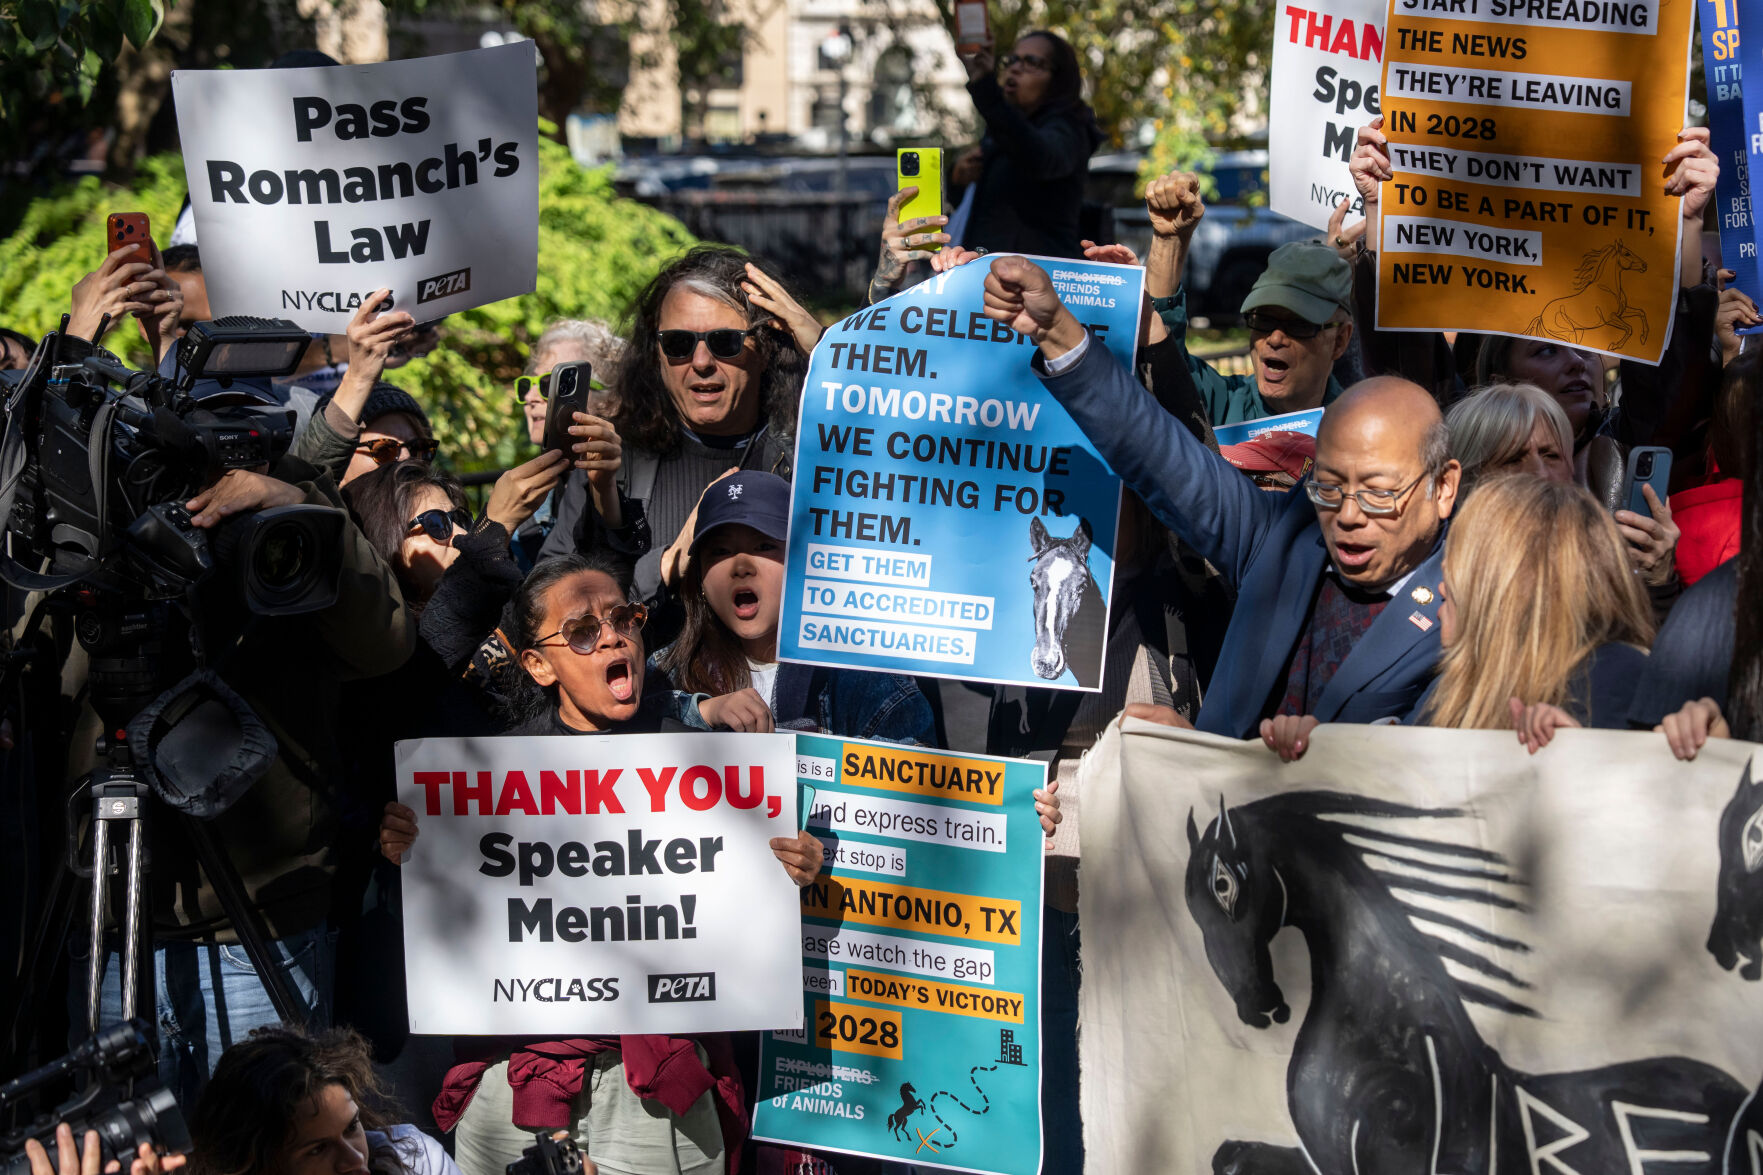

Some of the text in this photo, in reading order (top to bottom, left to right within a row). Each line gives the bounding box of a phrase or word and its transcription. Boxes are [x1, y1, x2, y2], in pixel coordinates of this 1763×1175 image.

[1490, 0, 1648, 27] SPREADING
[1286, 5, 1384, 63] THAN
[1397, 28, 1528, 60] THE NEWS
[1396, 69, 1621, 109] THEY'RE LEAVING
[292, 97, 431, 142] Pass
[1391, 110, 1497, 141] IN 2028
[206, 137, 520, 205] Romanch's
[1394, 149, 1632, 190] THEY DON'T WANT
[1394, 183, 1655, 237] TO BE A PART OF IT,
[314, 219, 431, 264] Law
[1396, 223, 1538, 263] NEW YORK,
[1393, 262, 1536, 296] NEW YORK.
[842, 306, 891, 333] WE
[1064, 294, 1116, 308] ANIMALS
[830, 342, 938, 379] THEM.
[821, 381, 1041, 431] TOMORROW
[817, 423, 1072, 476] WE CONTINUE
[813, 466, 1066, 518] FIGHTING FOR
[809, 507, 921, 547] THEM.
[809, 551, 927, 580] GET THEM
[807, 586, 990, 621] TO ACCREDITED
[802, 622, 970, 657] SANCTUARIES.
[413, 765, 782, 818] THANK YOU,
[811, 762, 822, 776] is
[825, 767, 833, 777] a
[844, 752, 1003, 796] SANCTUARY
[854, 807, 938, 837] express
[944, 815, 1003, 845] train.
[478, 829, 724, 887] Speaker
[850, 851, 886, 872] stop
[890, 853, 905, 871] is
[507, 894, 698, 943] Menin!
[839, 887, 971, 935] ANTONIO,
[980, 906, 1017, 936] TX
[847, 941, 907, 966] watch
[912, 947, 946, 971] the
[953, 957, 992, 981] gap
[493, 977, 619, 1002] NYCLASS
[849, 975, 929, 1004] TODAY'S
[936, 988, 1022, 1017] VICTORY
[819, 1011, 899, 1048] 2028
[774, 1075, 843, 1098] FRIENDS
[772, 1094, 865, 1120] of ANIMALS
